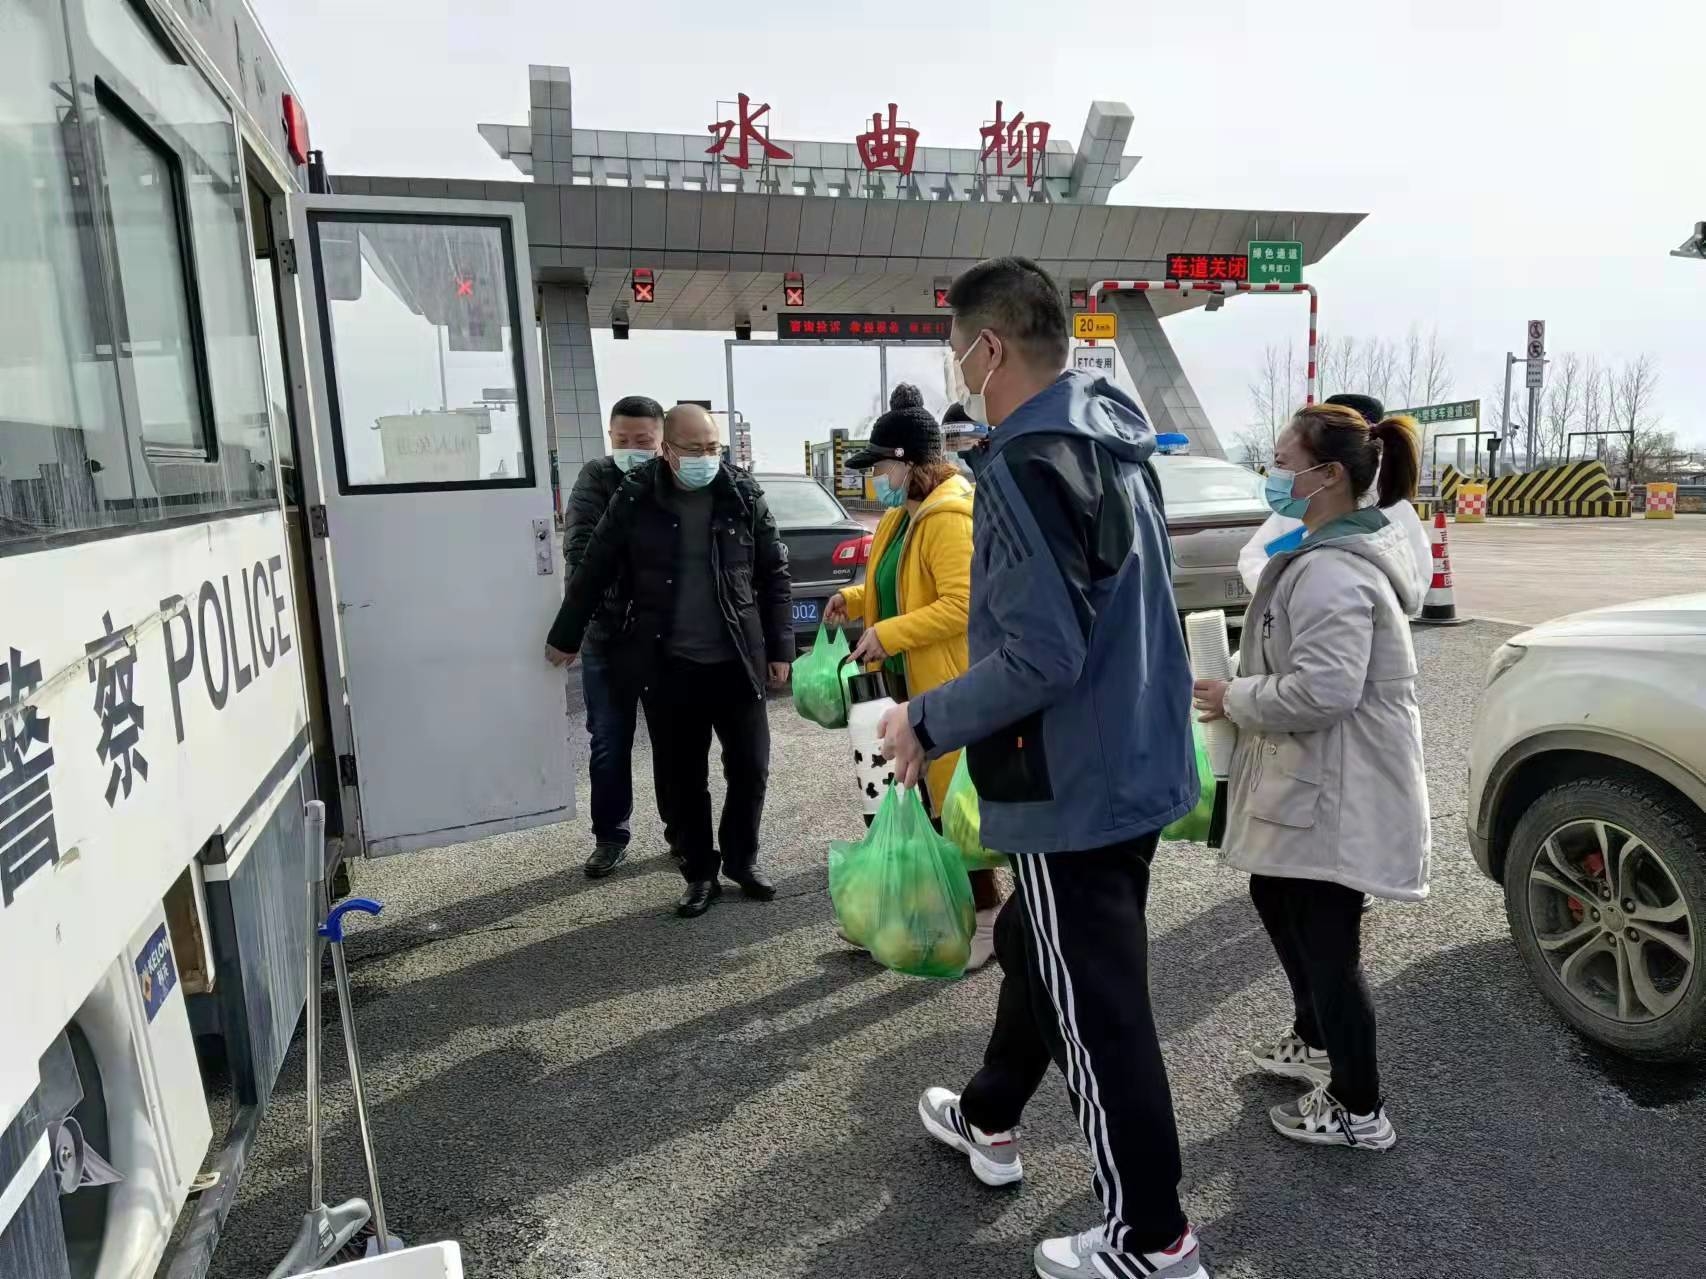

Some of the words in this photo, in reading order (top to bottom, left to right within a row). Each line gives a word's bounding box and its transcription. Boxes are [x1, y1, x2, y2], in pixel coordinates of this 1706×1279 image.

[704, 92, 1051, 188] 水曲柳
[1171, 256, 1247, 278] 车道关闭
[1252, 247, 1298, 260] 绿色通道
[1080, 318, 1094, 332] 20
[160, 554, 291, 744] POLICE
[147, 936, 170, 975] KELON
